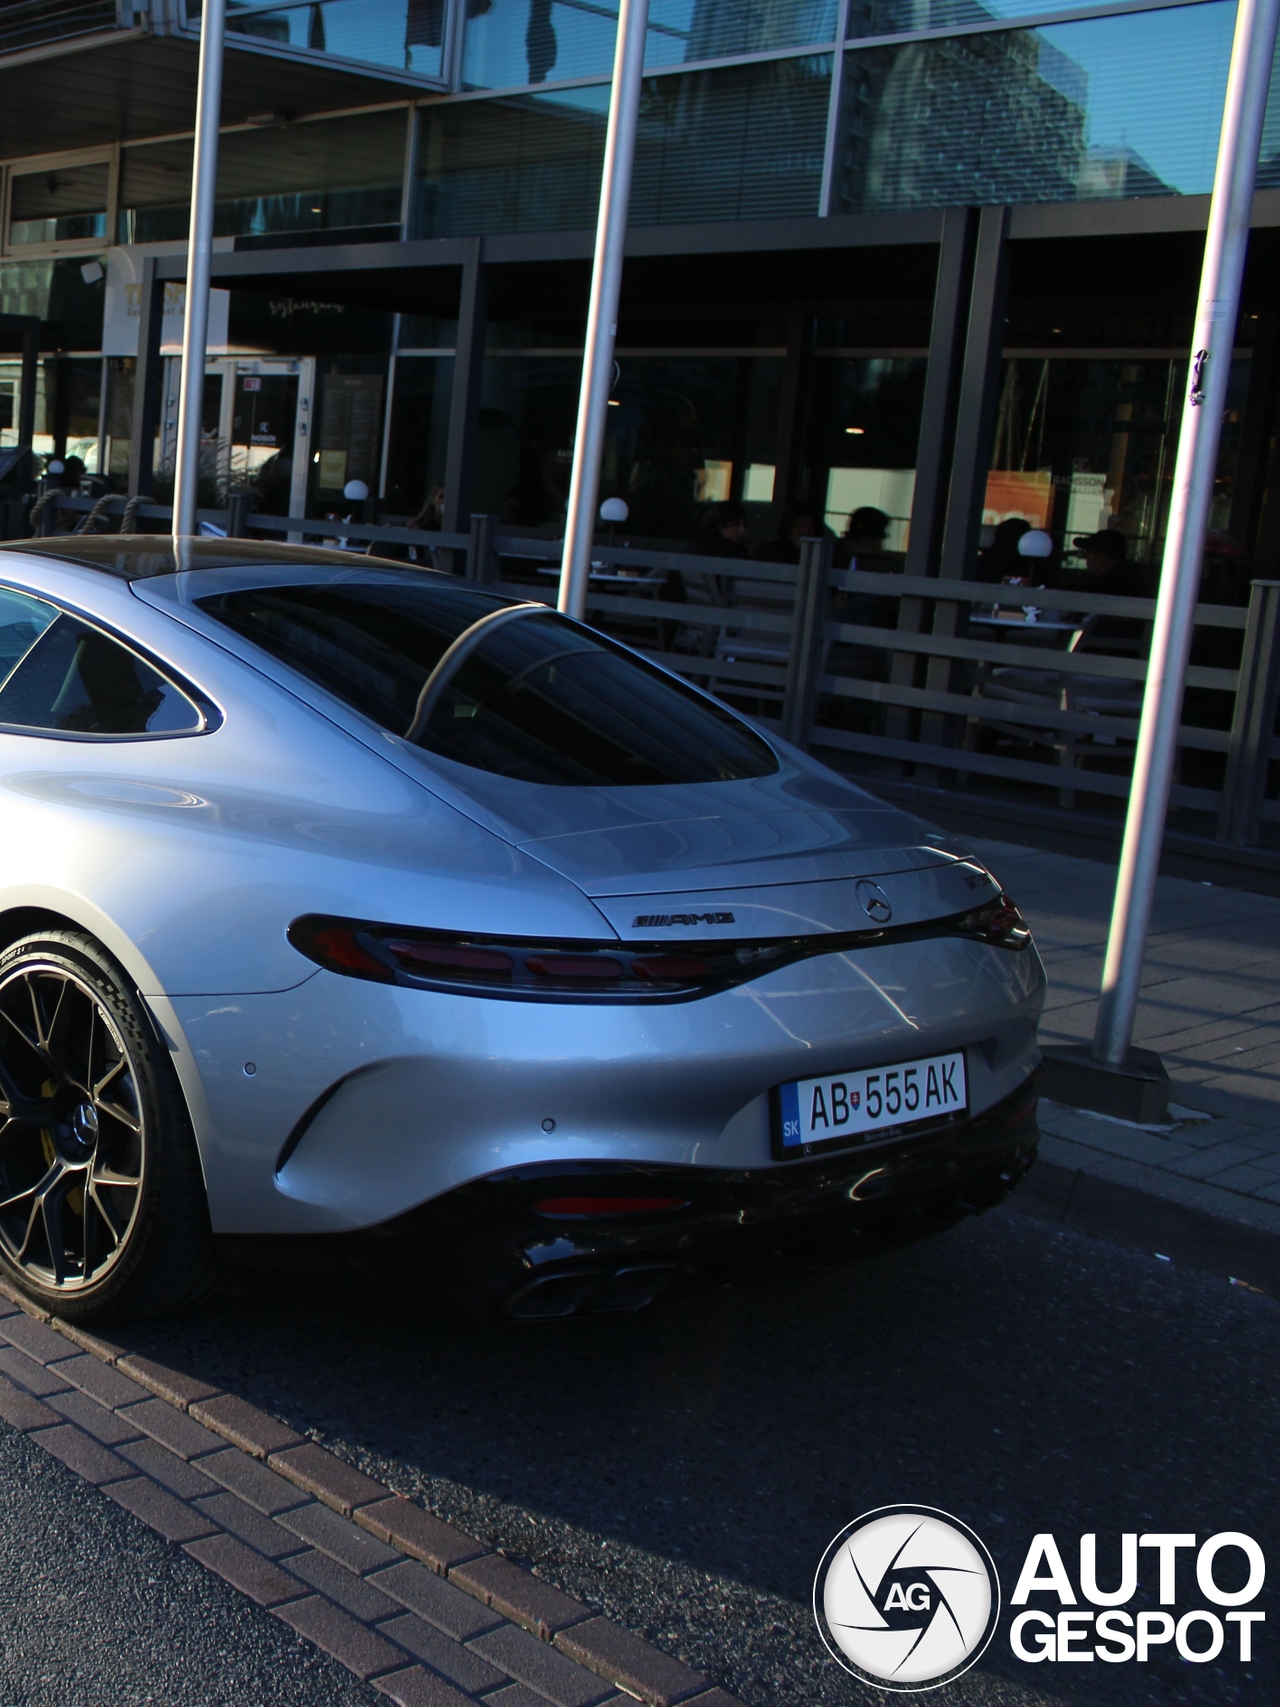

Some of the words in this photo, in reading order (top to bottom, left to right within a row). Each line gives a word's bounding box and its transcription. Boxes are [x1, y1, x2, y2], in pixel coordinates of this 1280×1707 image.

[1053, 475, 1105, 488] RADISSON
[663, 911, 736, 927] AMG
[810, 1081, 850, 1131] AB
[783, 1120, 799, 1137] SK
